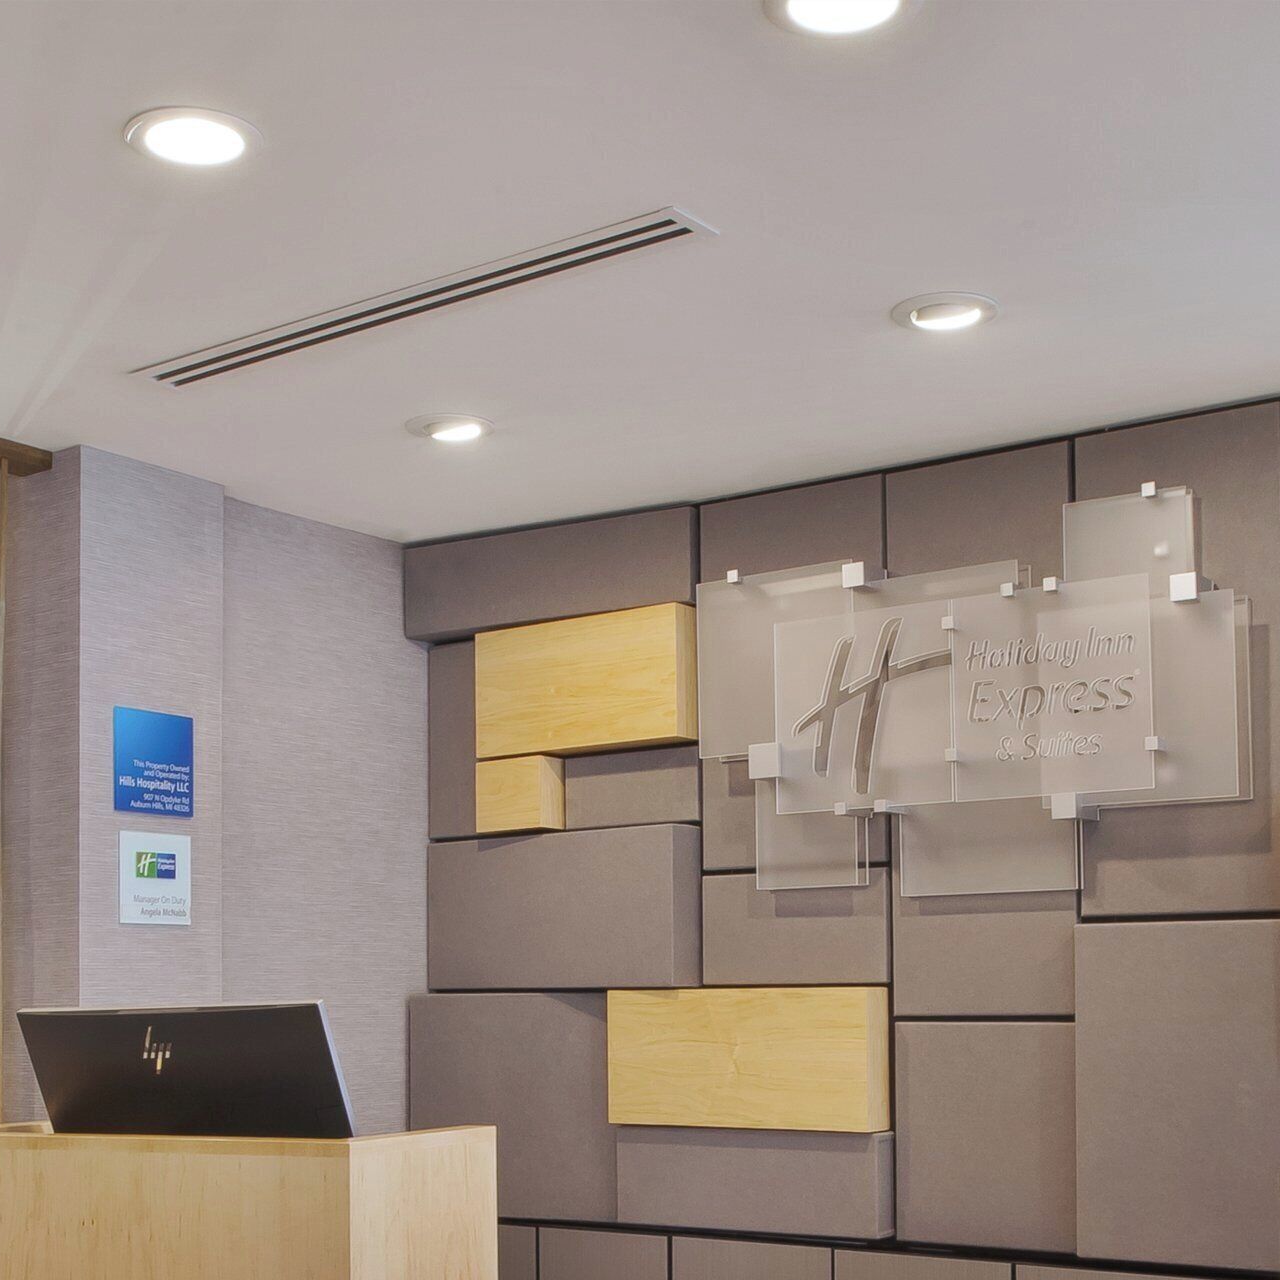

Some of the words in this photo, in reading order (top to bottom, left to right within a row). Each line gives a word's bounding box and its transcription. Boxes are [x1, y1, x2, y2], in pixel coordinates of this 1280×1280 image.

[965, 632, 1081, 671] Holiday
[1085, 626, 1135, 658] Inn
[968, 675, 1136, 730] Express
[995, 736, 1014, 761] &
[1021, 731, 1103, 760] Suites
[119, 776, 136, 787] Hills
[136, 778, 176, 793] Hospitality
[176, 782, 190, 793] LLC
[133, 895, 160, 906] Manager
[161, 896, 171, 904] On
[171, 896, 186, 907] Duty
[143, 1026, 172, 1075] hp
